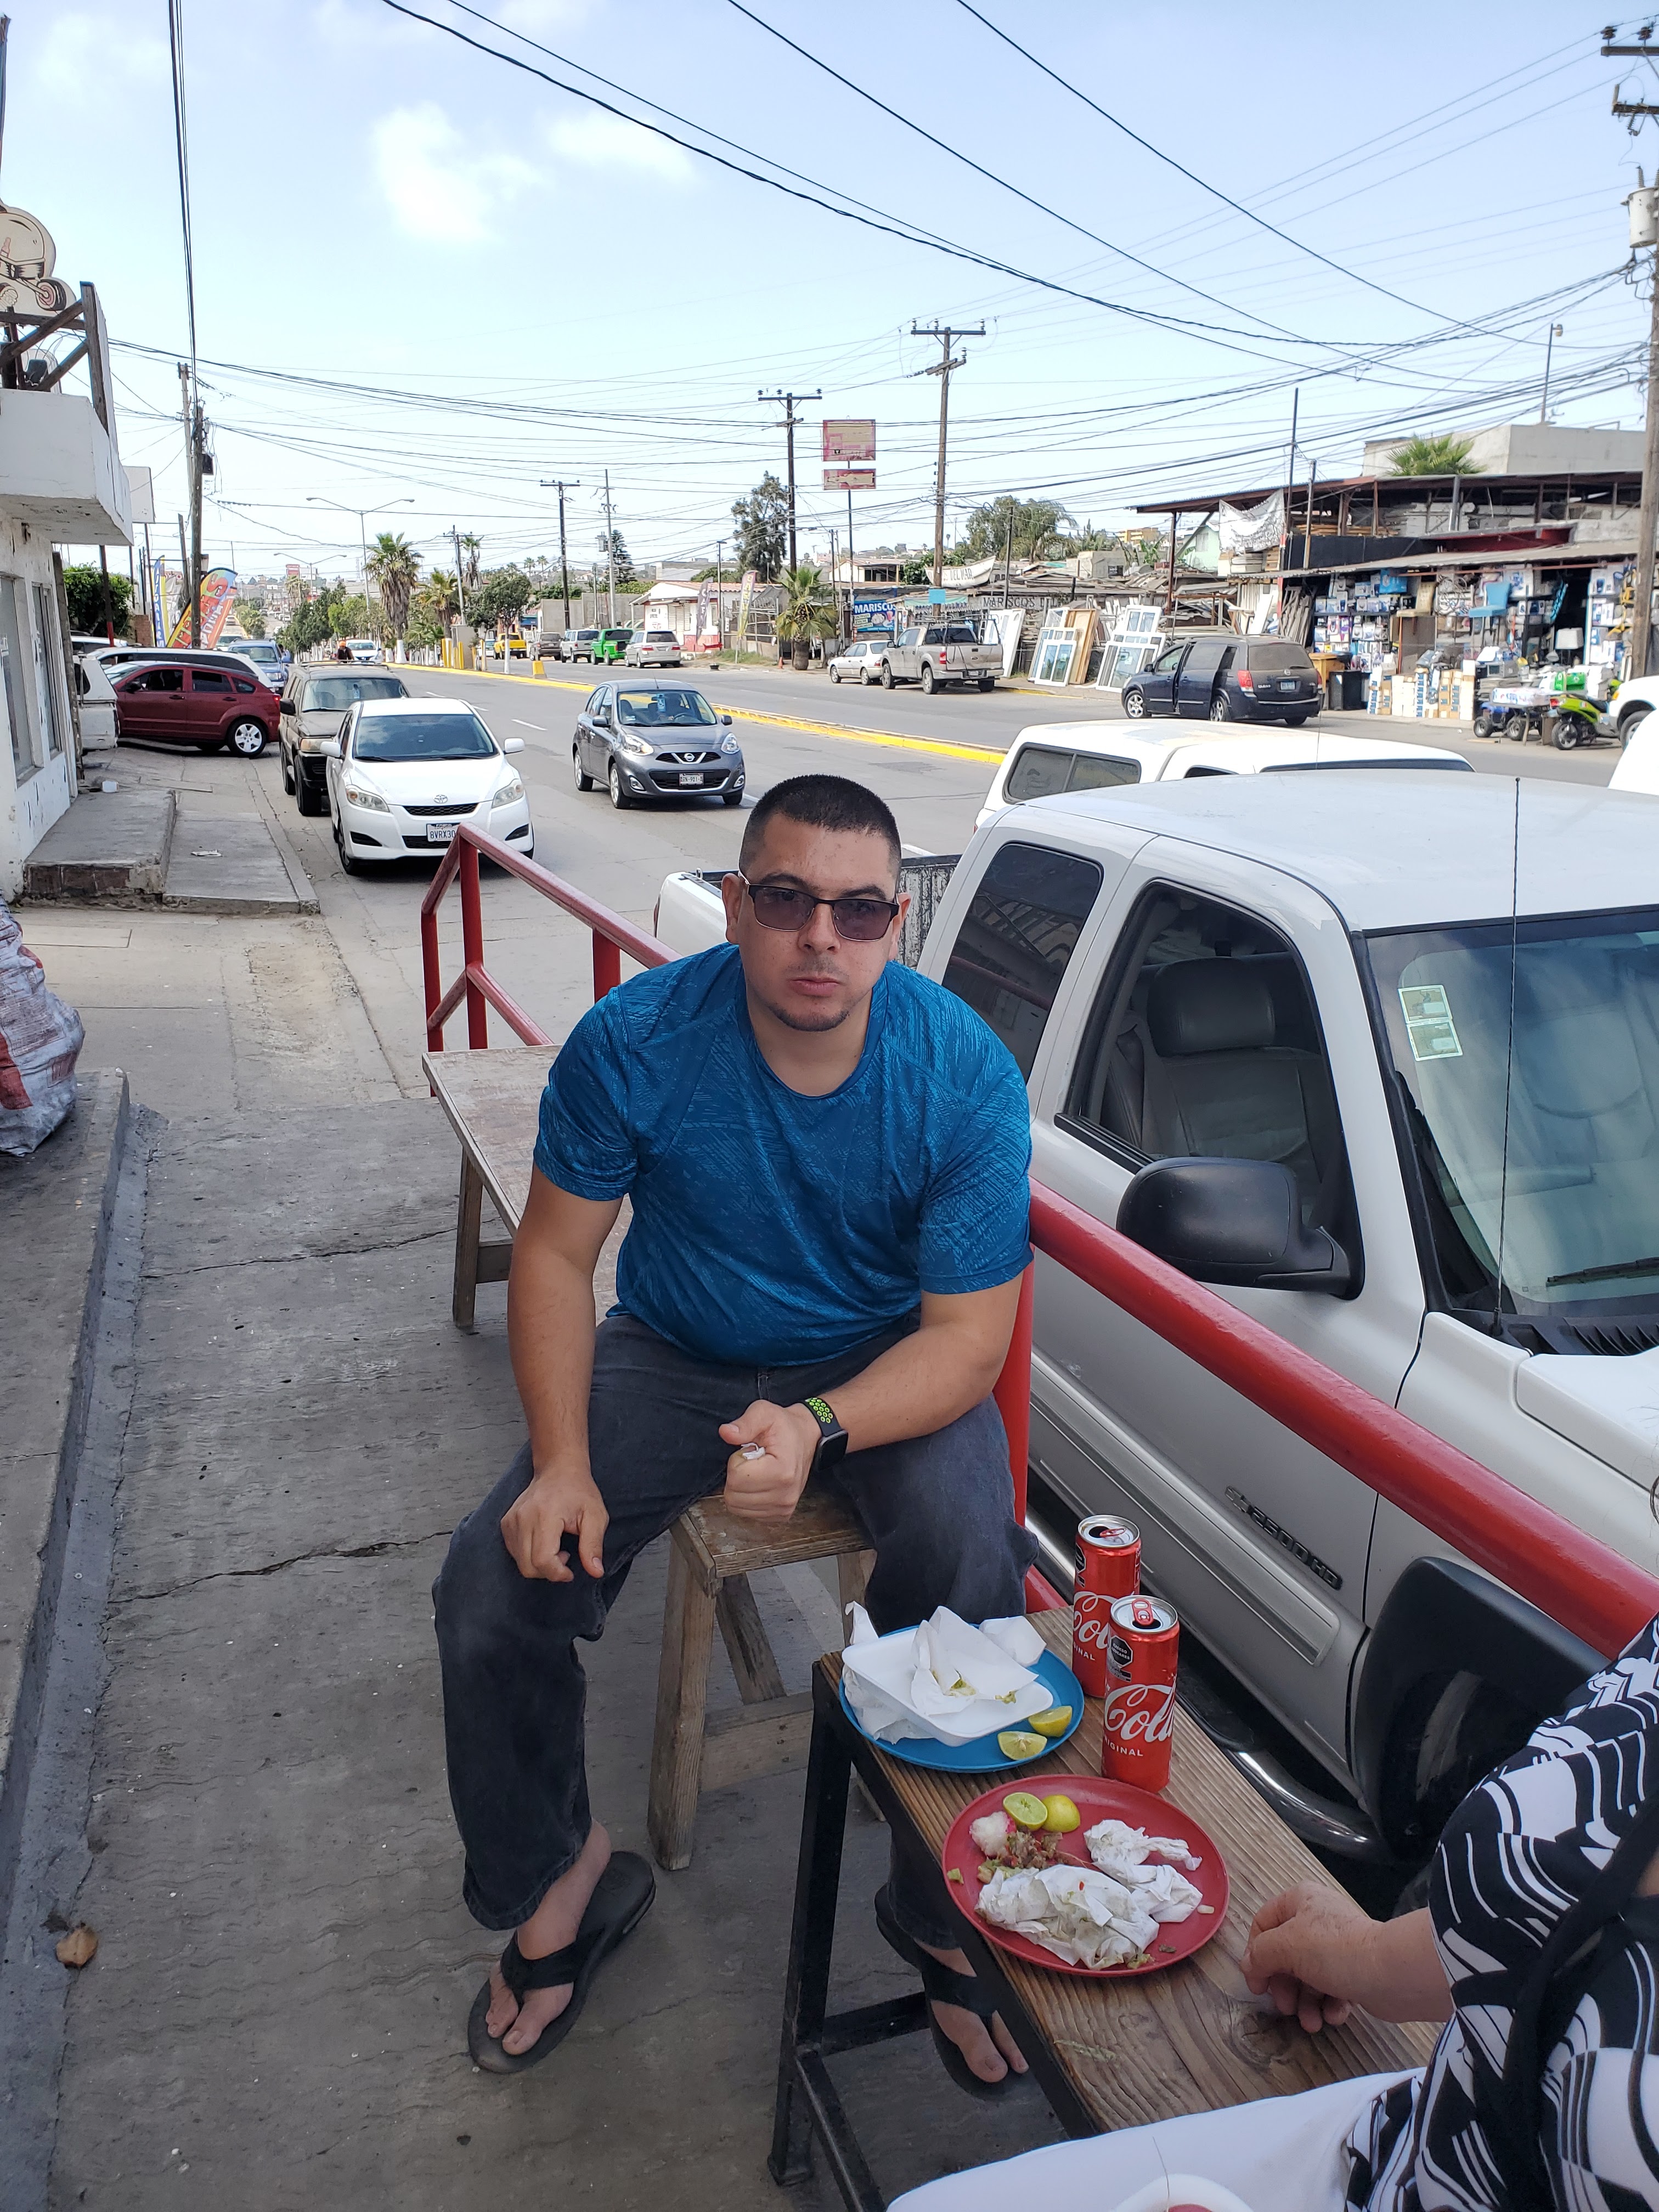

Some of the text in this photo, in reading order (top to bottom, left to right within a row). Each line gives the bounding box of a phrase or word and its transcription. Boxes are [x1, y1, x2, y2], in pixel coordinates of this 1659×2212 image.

[983, 596, 1035, 608] MARSCOS
[1250, 1506, 1311, 1566] 2500
[1073, 1643, 1096, 1661] GINAL
[1113, 1643, 1127, 1654] EXCESO
[1104, 1731, 1144, 1757] RIGINAL
